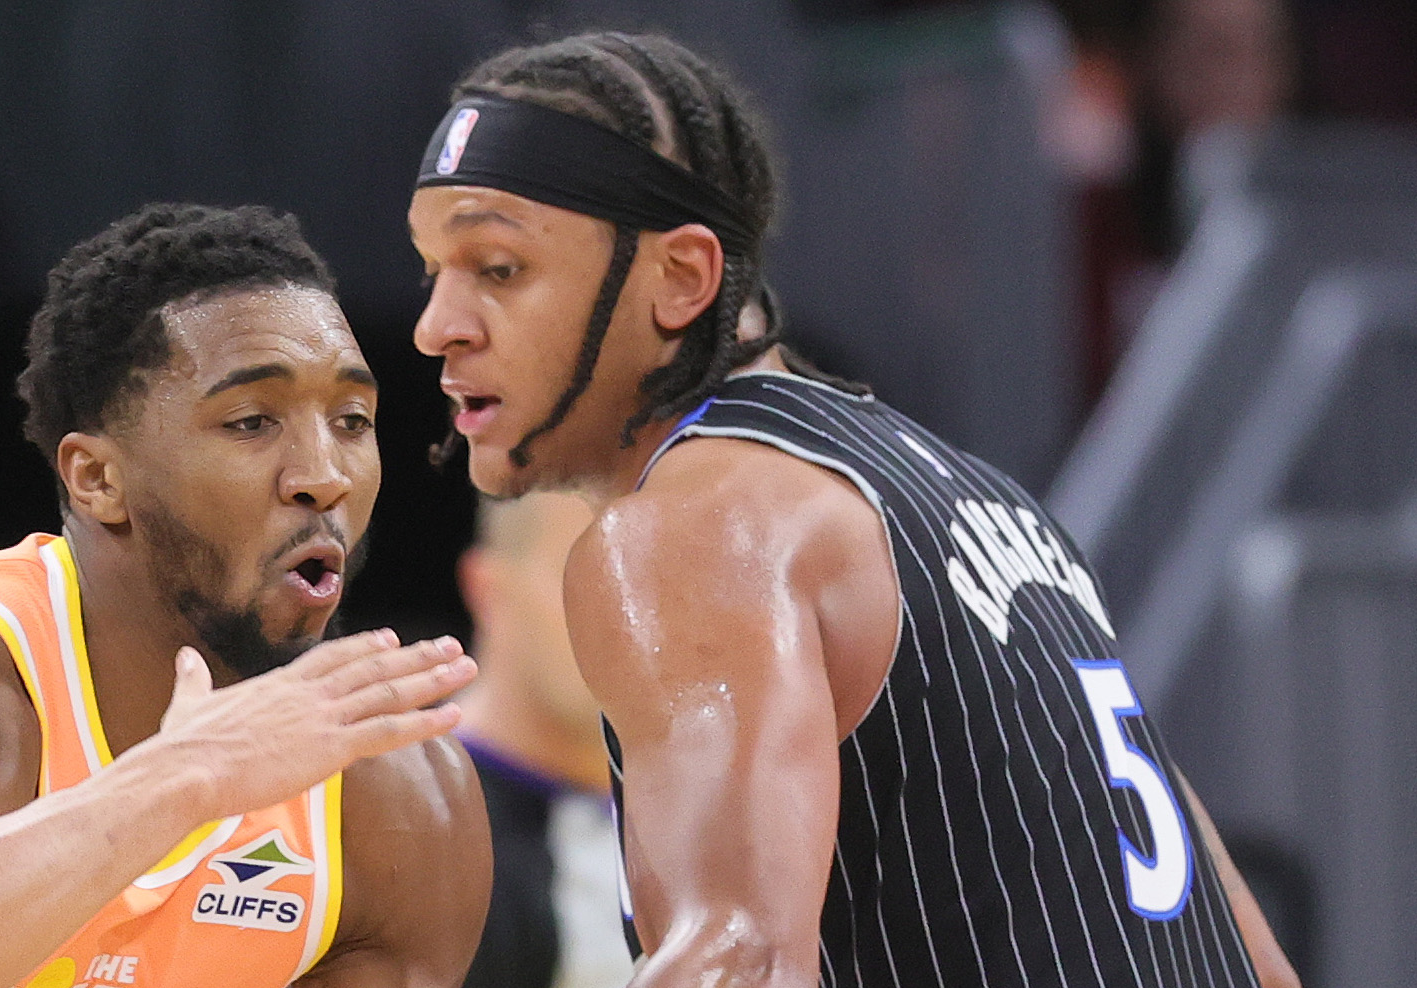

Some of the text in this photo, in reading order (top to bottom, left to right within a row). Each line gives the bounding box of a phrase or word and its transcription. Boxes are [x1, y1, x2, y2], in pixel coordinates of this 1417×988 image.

[1070, 658, 1195, 921] 5
[196, 892, 299, 924] CLIFFS
[84, 953, 139, 985] THE
